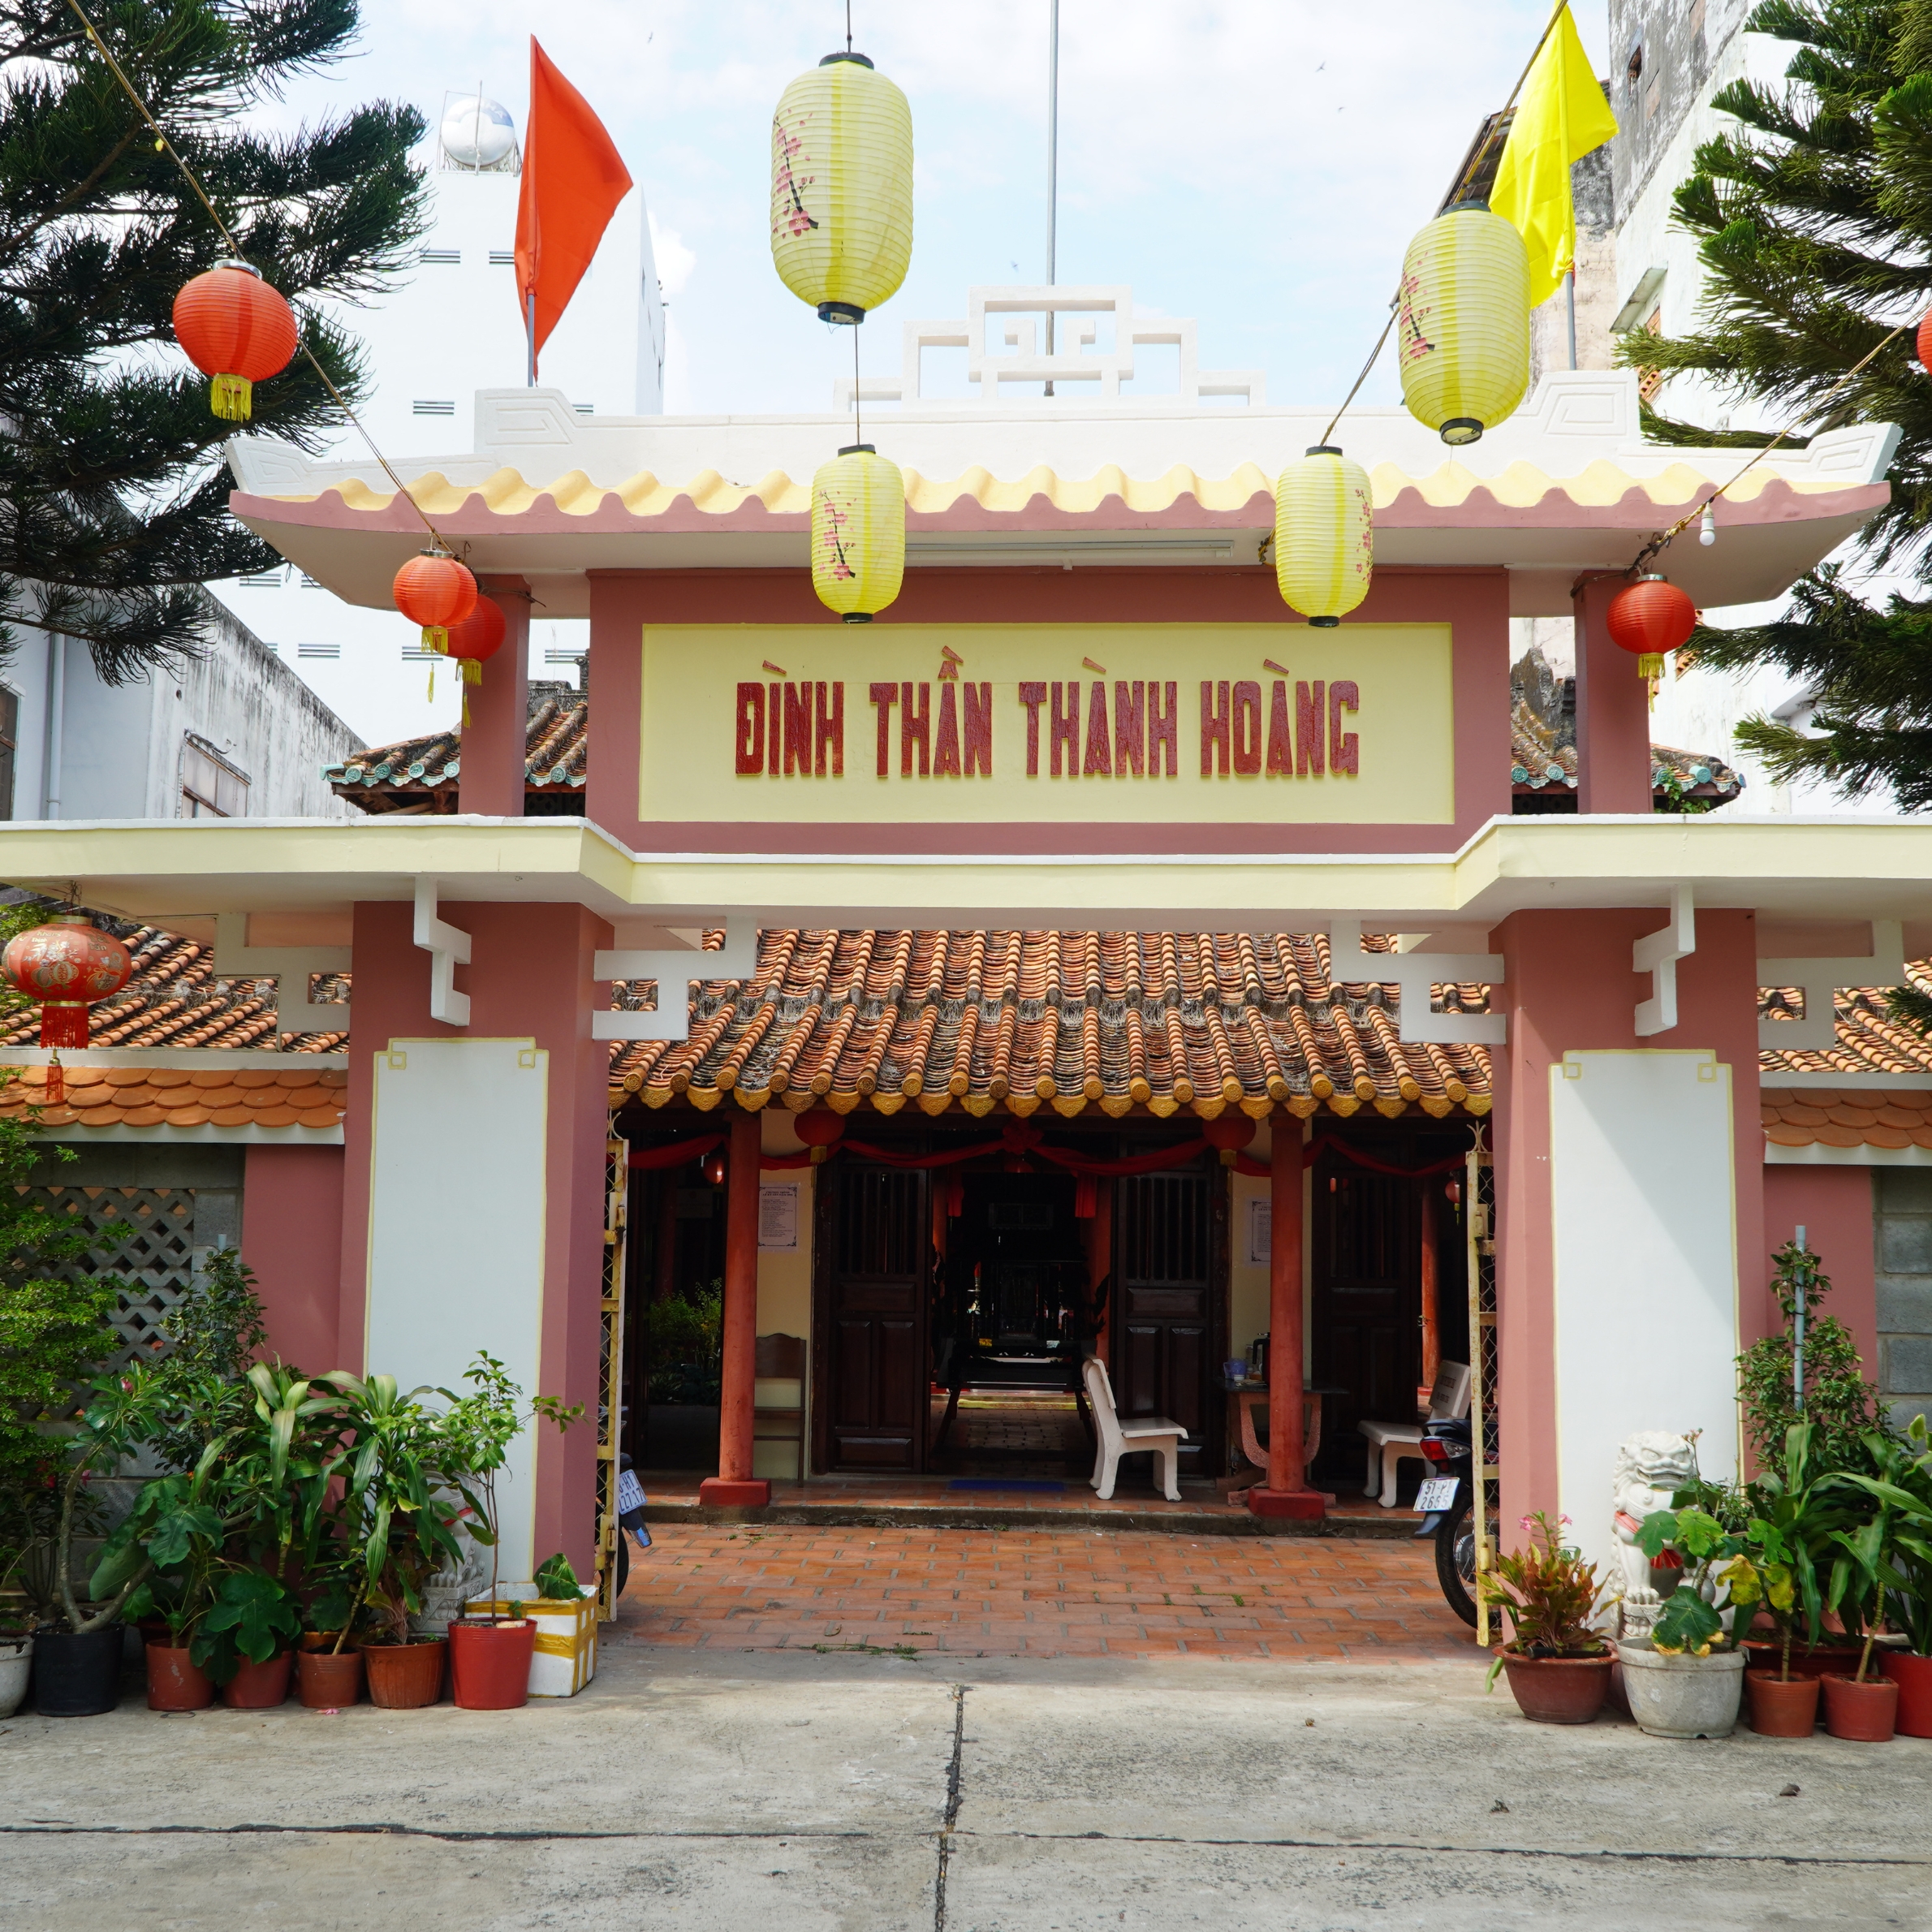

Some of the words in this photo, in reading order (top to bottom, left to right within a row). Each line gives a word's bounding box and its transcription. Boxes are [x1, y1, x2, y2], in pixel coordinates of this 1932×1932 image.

[735, 660, 845, 776] ĐÌNH
[869, 646, 993, 777] THẦN
[1019, 657, 1178, 776] THÀNH
[1201, 658, 1360, 776] HOÀNG
